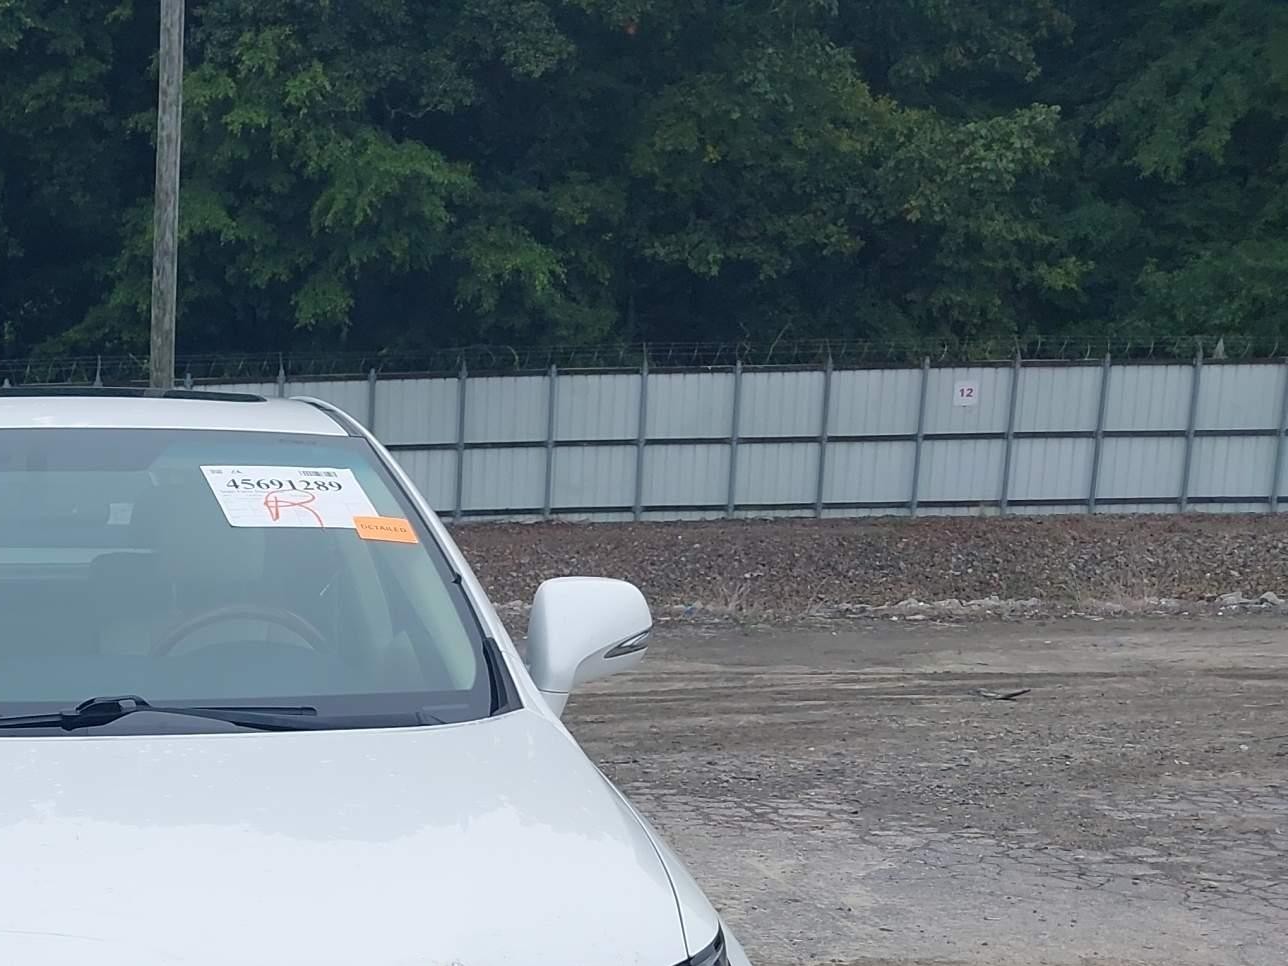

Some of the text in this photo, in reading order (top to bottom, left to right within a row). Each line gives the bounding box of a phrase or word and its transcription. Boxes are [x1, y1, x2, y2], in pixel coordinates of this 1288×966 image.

[959, 387, 974, 398] 12
[226, 478, 342, 492] 45691289
[359, 523, 407, 533] DETAILED
